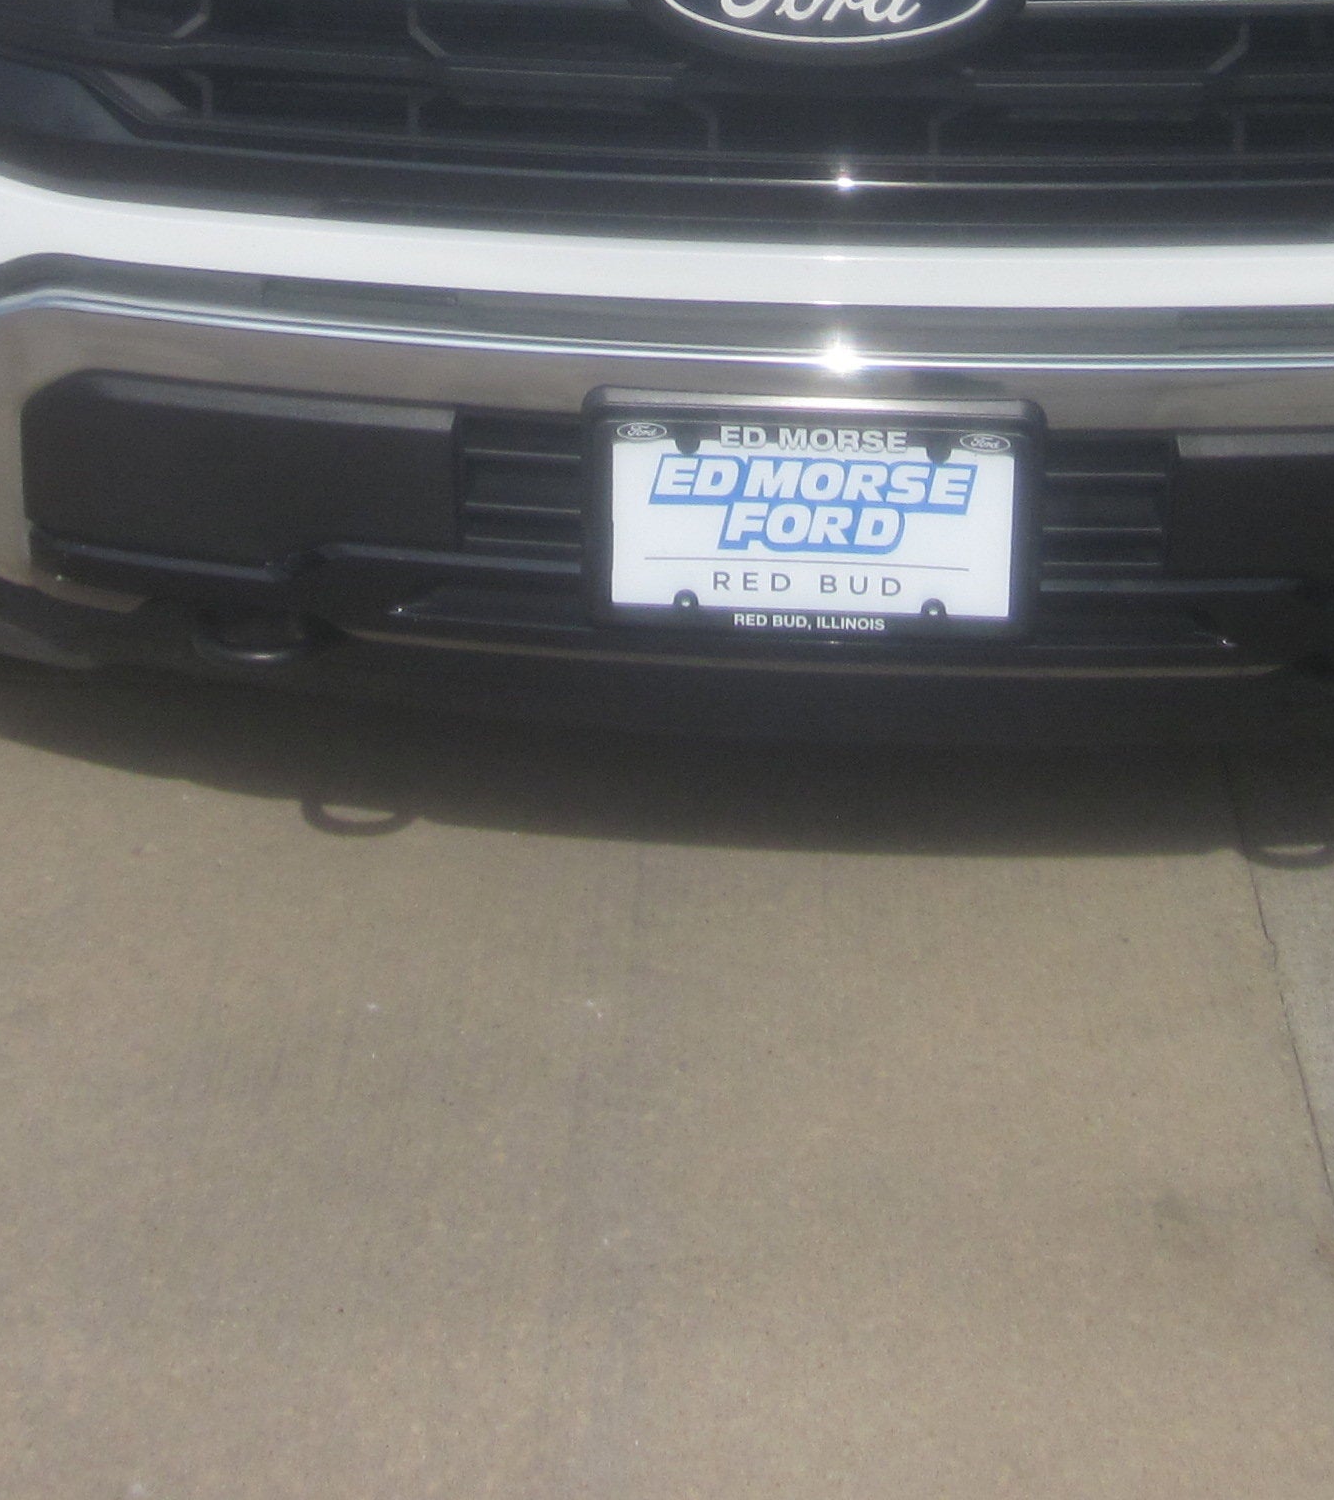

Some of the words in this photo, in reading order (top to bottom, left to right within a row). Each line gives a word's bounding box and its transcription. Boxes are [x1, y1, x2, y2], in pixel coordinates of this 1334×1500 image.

[626, 423, 658, 438] Ford
[720, 425, 767, 449] ED
[778, 427, 908, 453] MORSE
[969, 435, 1001, 450] Ford
[653, 456, 741, 499] ED
[741, 458, 973, 508] MORSE
[722, 505, 902, 549] FORD
[712, 571, 792, 592] RED
[819, 574, 903, 597] BUD
[733, 612, 768, 627] RED
[772, 614, 812, 631] BUD,
[816, 616, 886, 632] ILLINOIS
